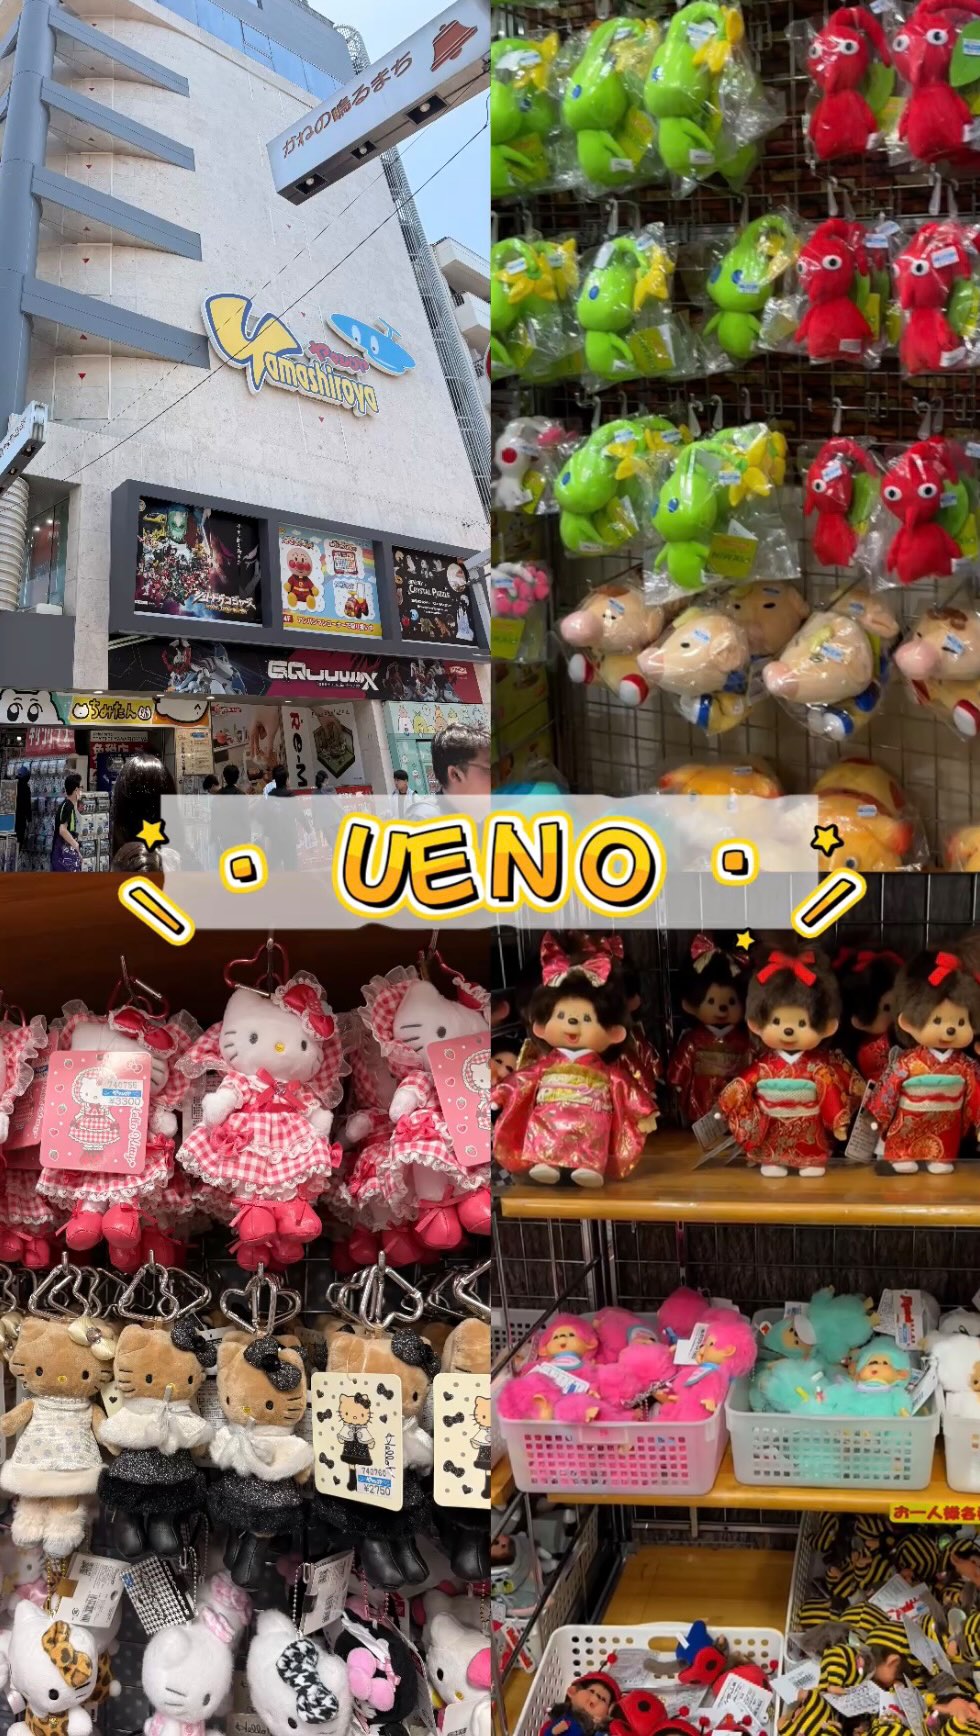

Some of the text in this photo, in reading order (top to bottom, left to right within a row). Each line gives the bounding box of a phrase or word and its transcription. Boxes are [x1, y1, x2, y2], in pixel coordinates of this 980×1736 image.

[282, 51, 413, 159] かねの鳴るまち
[204, 293, 380, 415] Yamashiroya
[363, 1483, 391, 1496] ¥2750
[894, 1505, 980, 1521] お一人様各
